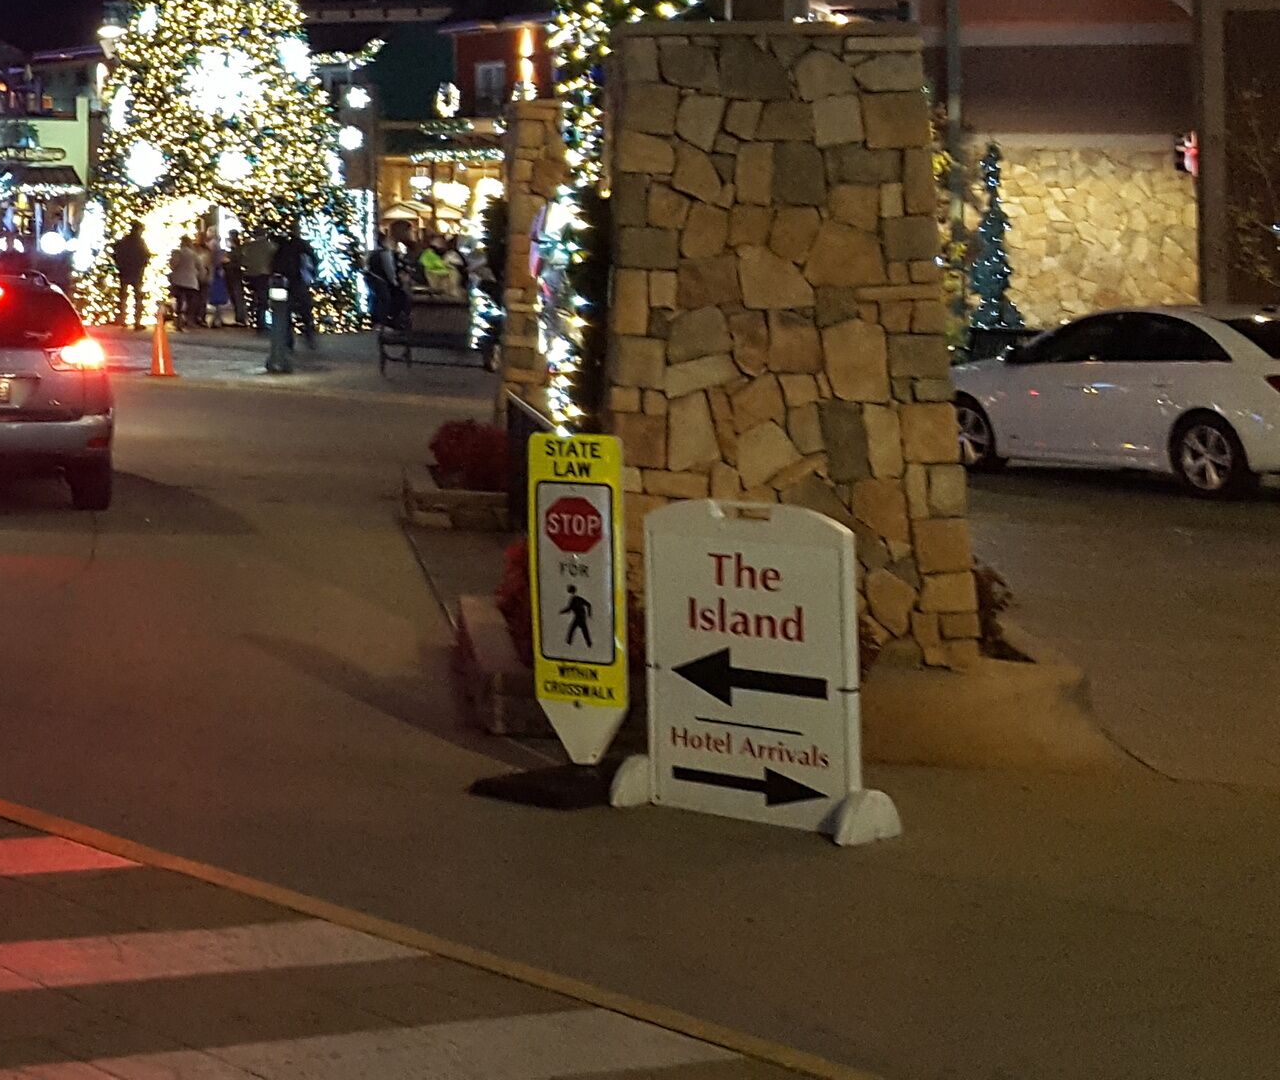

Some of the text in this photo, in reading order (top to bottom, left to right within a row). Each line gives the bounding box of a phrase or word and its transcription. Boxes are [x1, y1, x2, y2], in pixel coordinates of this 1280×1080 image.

[545, 440, 602, 459] STATE
[553, 461, 591, 478] LAW
[547, 513, 602, 536] STOP
[559, 561, 590, 578] FOR
[707, 552, 782, 592] The
[687, 596, 805, 642] Island
[544, 680, 616, 700] CROSSWALK
[670, 726, 831, 768] Hotel Arrivals
